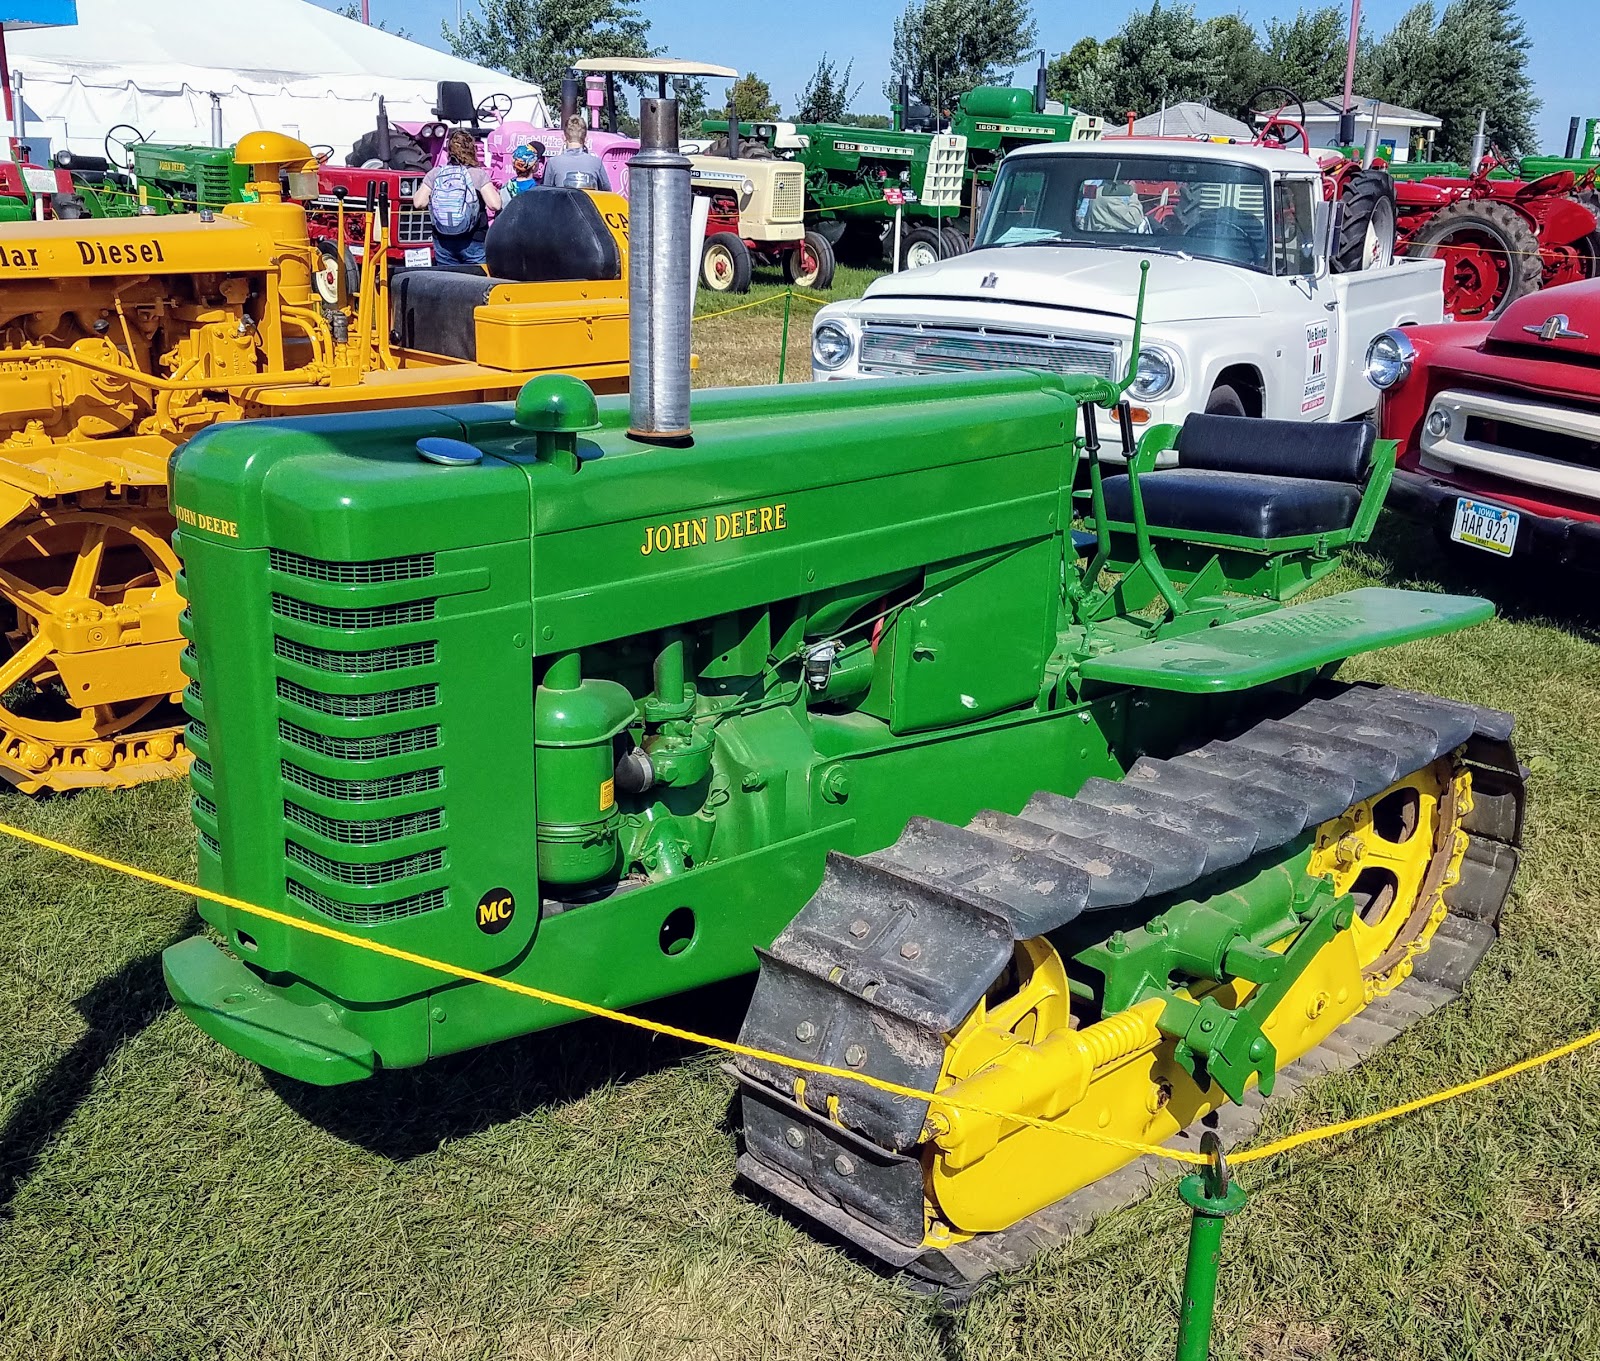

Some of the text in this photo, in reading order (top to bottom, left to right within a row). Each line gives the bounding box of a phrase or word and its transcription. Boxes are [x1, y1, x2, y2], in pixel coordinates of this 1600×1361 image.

[864, 146, 907, 154] OLIVER
[159, 161, 185, 173] JOHN DEERE
[76, 240, 164, 265] Diesel
[1315, 326, 1328, 340] Binder
[175, 505, 239, 538] JOHN DEERE
[1478, 507, 1496, 518] IOWA
[640, 503, 787, 556] JOHN DEERE
[1461, 512, 1508, 543] HAR 923
[479, 898, 512, 925] MC
